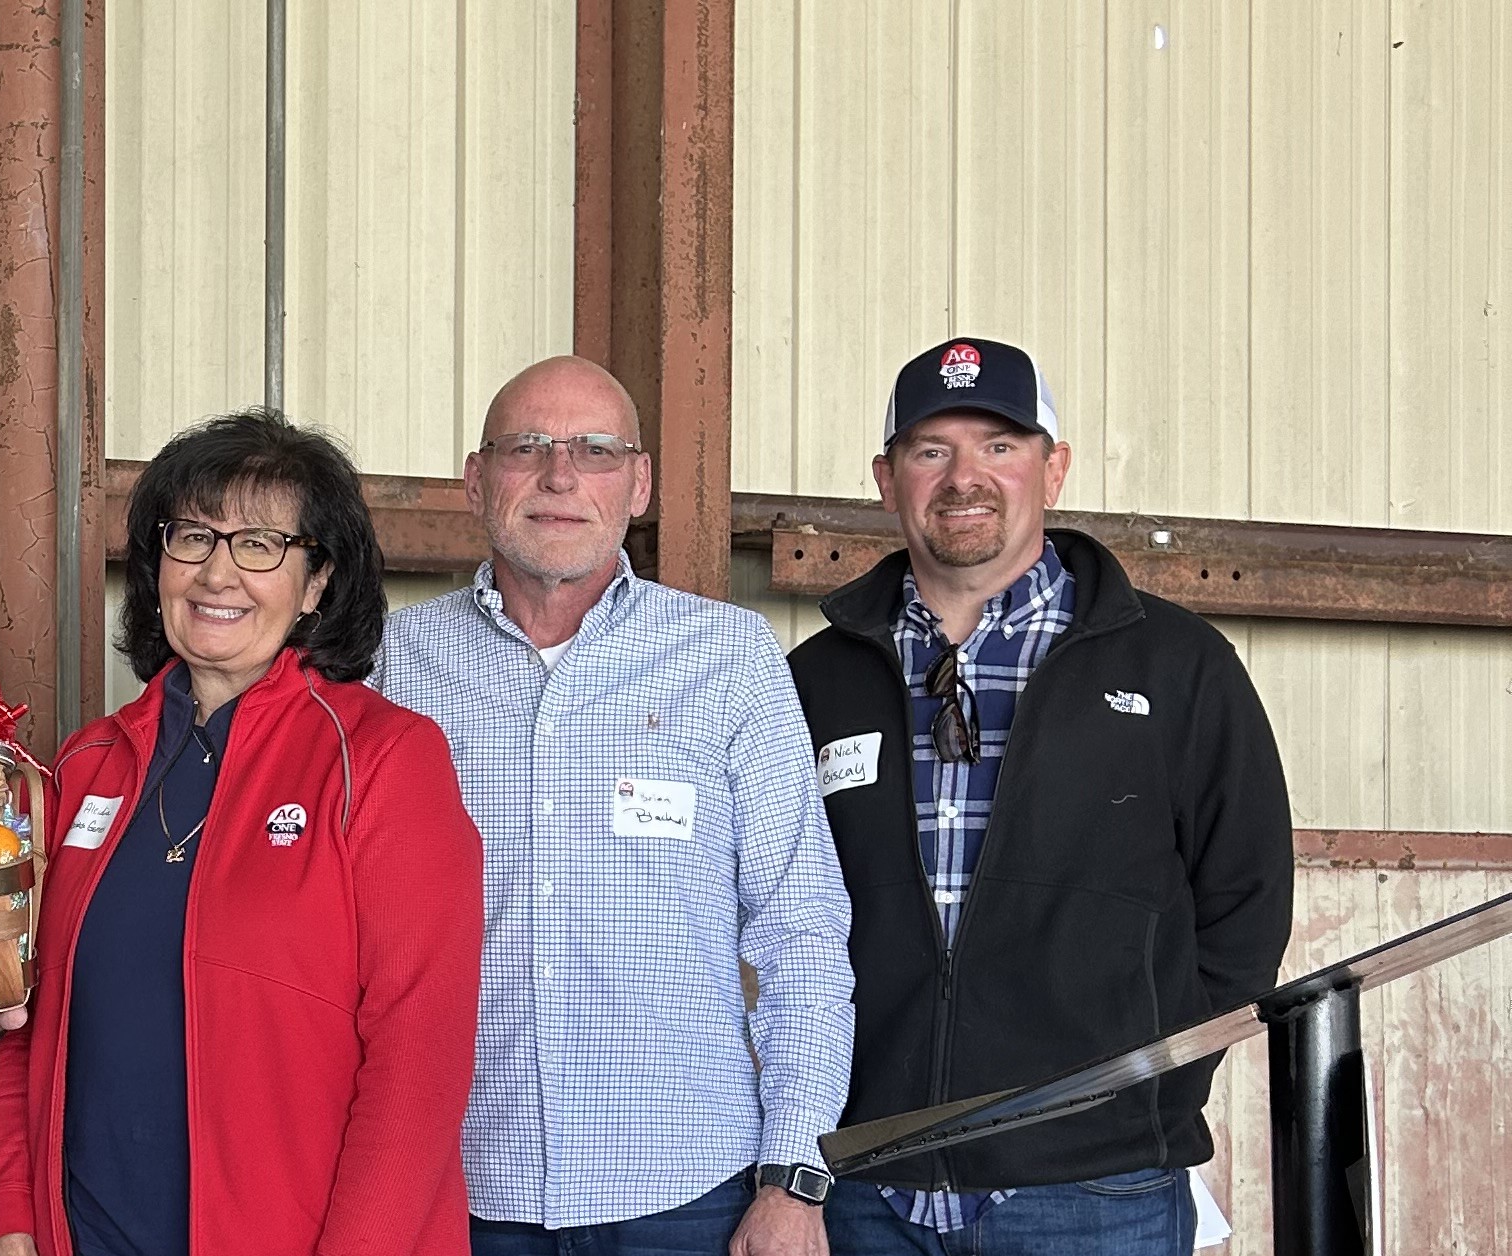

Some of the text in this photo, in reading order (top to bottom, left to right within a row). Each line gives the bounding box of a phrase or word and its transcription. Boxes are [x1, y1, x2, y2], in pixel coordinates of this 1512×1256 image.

[945, 348, 976, 365] AG
[946, 364, 972, 375] ONE
[834, 740, 862, 758] Nick
[822, 762, 866, 785] Biscay
[274, 806, 301, 821] AG
[271, 823, 297, 833] ONE
